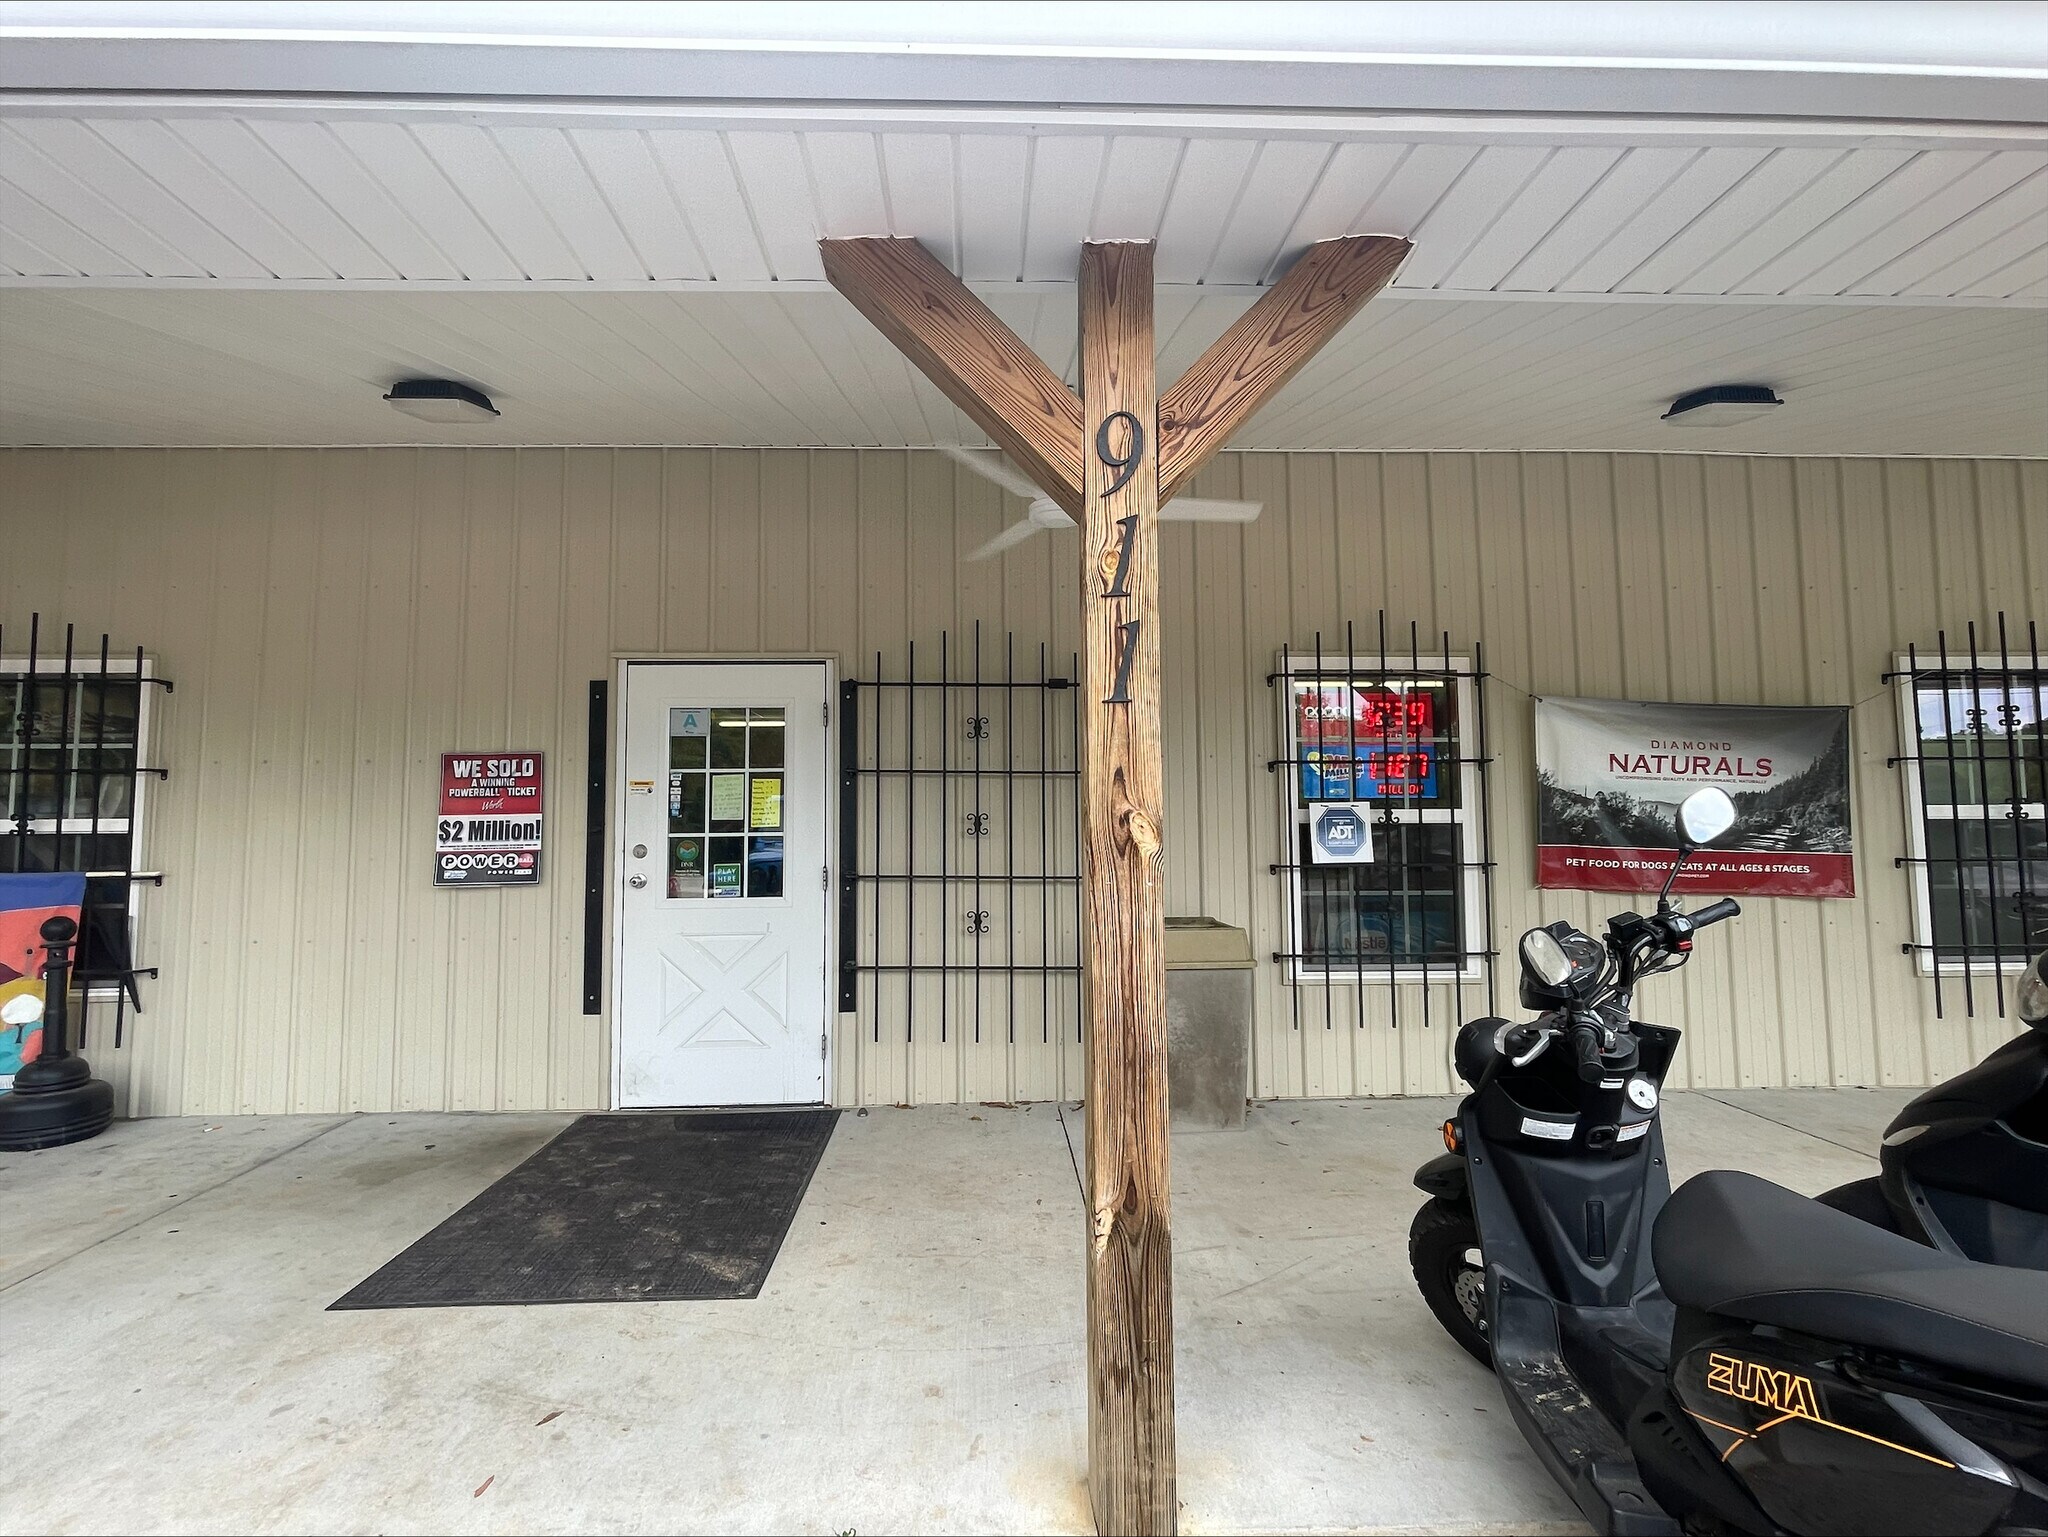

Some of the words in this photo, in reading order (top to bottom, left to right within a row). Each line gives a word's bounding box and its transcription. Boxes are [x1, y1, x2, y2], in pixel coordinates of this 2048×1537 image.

[682, 714, 698, 728] A
[1650, 740, 1732, 751] DIAMOND
[452, 759, 482, 778] WE
[487, 758, 534, 778] SOLD
[1608, 754, 1773, 777] NATURALS
[471, 778, 478, 787] A
[479, 778, 516, 787] WINNING
[1378, 784, 1423, 795] MILLO
[449, 788, 500, 797] POWERBALL
[507, 787, 536, 796] TICKET
[438, 820, 464, 844] $2
[468, 819, 541, 841] Million!
[1328, 825, 1354, 840] ADT
[1566, 858, 1587, 867] PET
[1589, 859, 1620, 868] FOOD
[1622, 860, 1640, 869] FOR
[1641, 861, 1668, 870] DOGS
[1680, 862, 1703, 871] CATS
[1705, 863, 1716, 871] AT
[1719, 864, 1737, 872] ALL
[1739, 864, 1763, 872] AGES
[1764, 864, 1770, 872] &
[1772, 864, 1810, 874] STAGES
[1344, 936, 1386, 950] Nstlé
[1708, 1352, 1822, 1421] ZUMA
